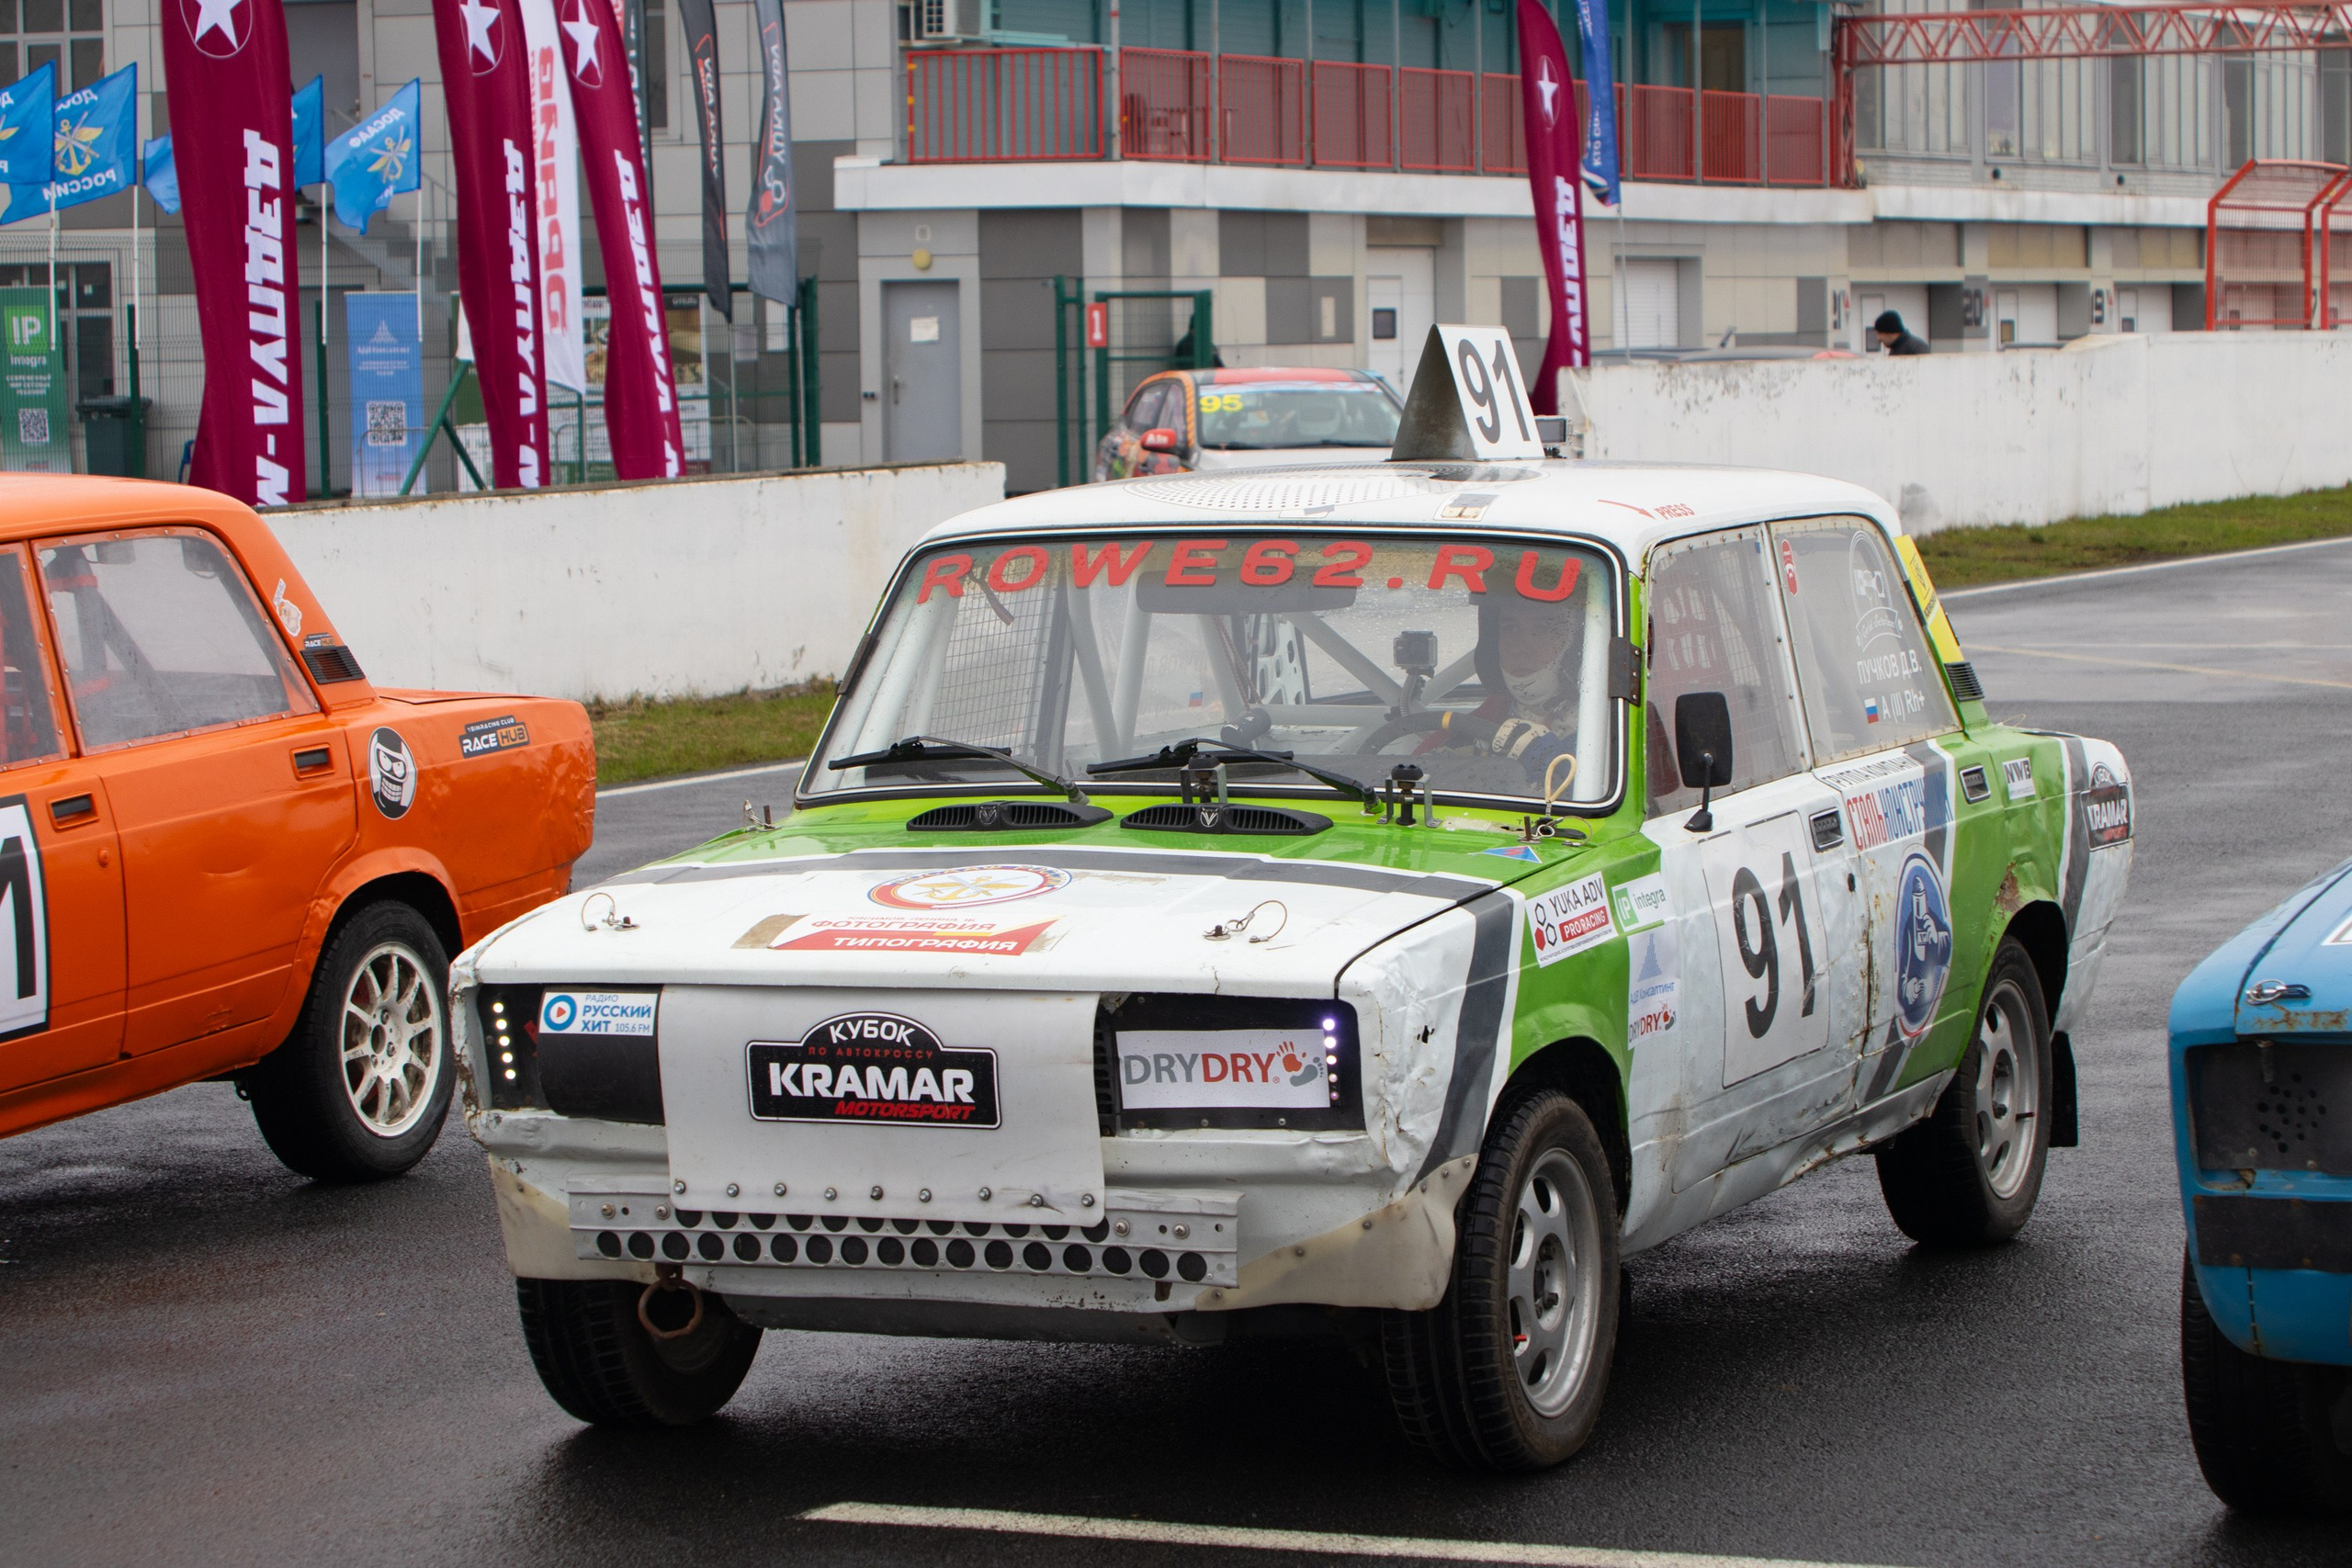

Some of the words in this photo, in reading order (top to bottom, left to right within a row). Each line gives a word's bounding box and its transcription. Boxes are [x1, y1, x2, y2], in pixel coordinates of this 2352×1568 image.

[12, 316, 41, 345] IP
[1457, 338, 1532, 443] 91
[1199, 394, 1243, 413] 95
[1654, 502, 1695, 521] PRESS
[917, 538, 1583, 604] ROWE62.RU
[1856, 653, 1899, 685] ПУЧКОВ
[1905, 689, 1925, 716] Rh+
[462, 733, 498, 753] RACE
[500, 728, 526, 744] HUB
[2004, 759, 2031, 784] NWB
[1549, 888, 1583, 917] YUKA
[1582, 877, 1603, 906] ADV
[1618, 898, 1632, 920] IP
[1633, 888, 1666, 909] integra
[811, 919, 997, 931] ФОТОГРАФИЯ
[1564, 921, 1581, 939] PRO
[1580, 909, 1606, 934] RACING
[832, 936, 1019, 952] ТИПОГРАФИЯ
[1732, 852, 1815, 1039] 91
[585, 994, 618, 1003] РАДИО
[582, 1005, 651, 1018] РУССКИЙ
[581, 1020, 611, 1032] ХИТ
[615, 1022, 636, 1032] 105.6
[638, 1023, 650, 1033] FM
[829, 1019, 915, 1047] КУБОК
[808, 1045, 827, 1055] ПО
[836, 1046, 933, 1060] АВТОКРОССУ
[768, 1062, 976, 1103] KRAMAR
[834, 1100, 976, 1121] MOTORSPORT
